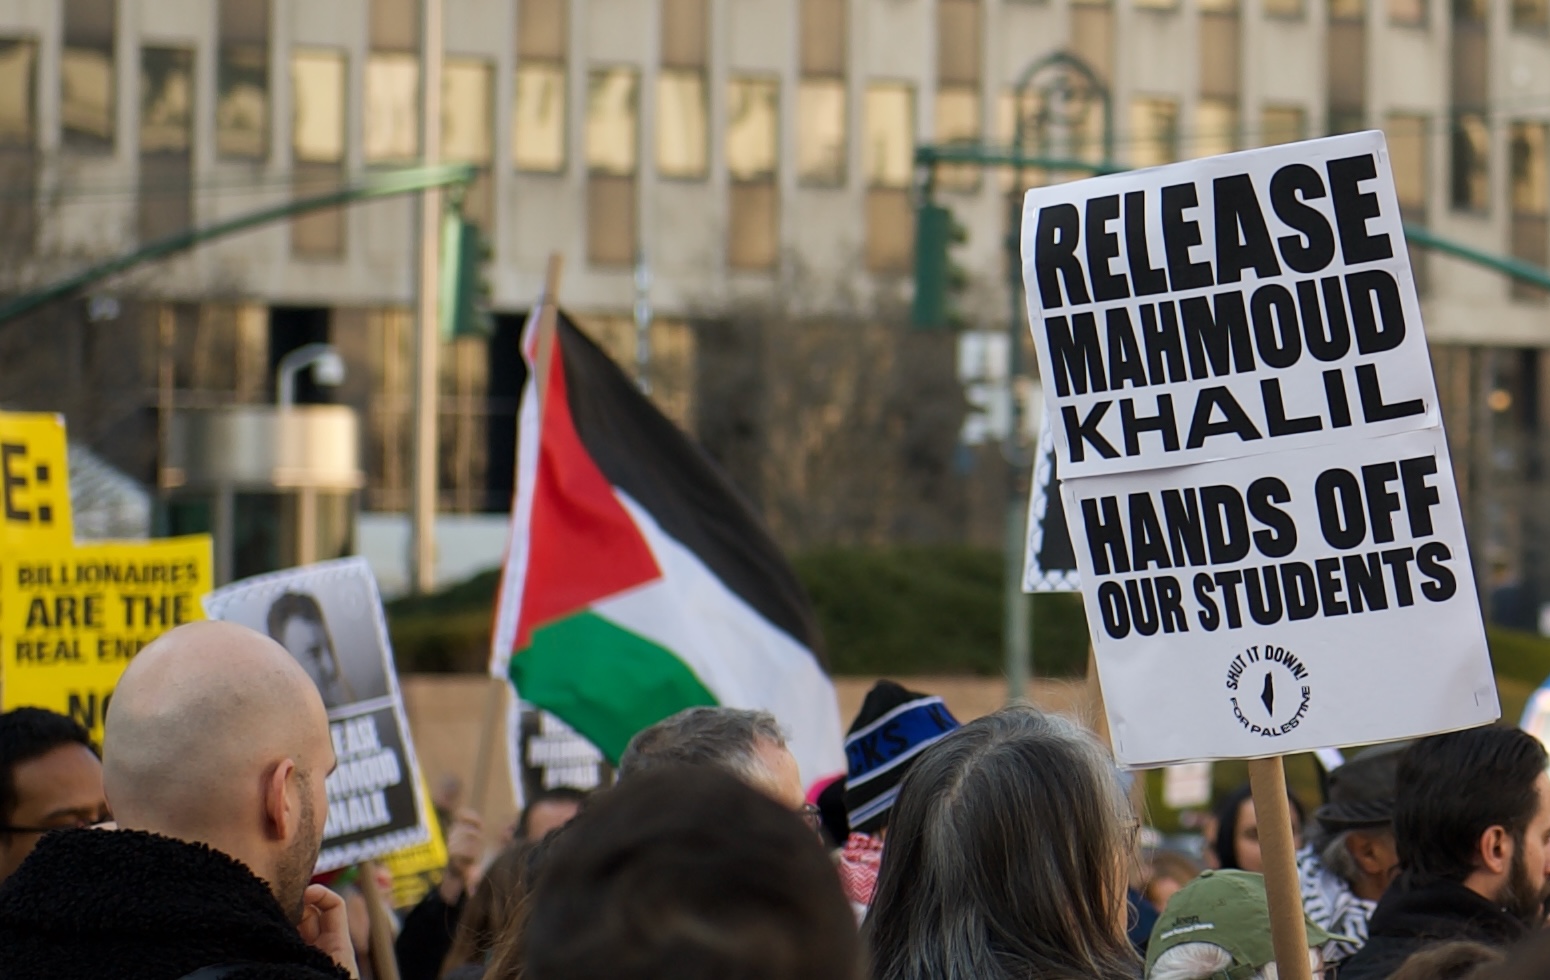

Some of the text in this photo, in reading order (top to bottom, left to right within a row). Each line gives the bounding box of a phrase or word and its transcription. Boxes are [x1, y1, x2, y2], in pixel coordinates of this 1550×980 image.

[1035, 153, 1393, 309] RELEASE
[1044, 269, 1407, 397] MAHMOUD
[1061, 362, 1425, 463] KHALIL
[1081, 455, 1440, 575] HANDS OFF
[17, 563, 198, 586] BILLIONAIRES
[26, 593, 192, 628] ARE THE
[1097, 541, 1457, 640] OUR STUDENTS
[16, 640, 84, 664] REAL
[1226, 645, 1309, 690] SHUT IT DOWN!
[1230, 686, 1310, 737] FOR PALESTINE
